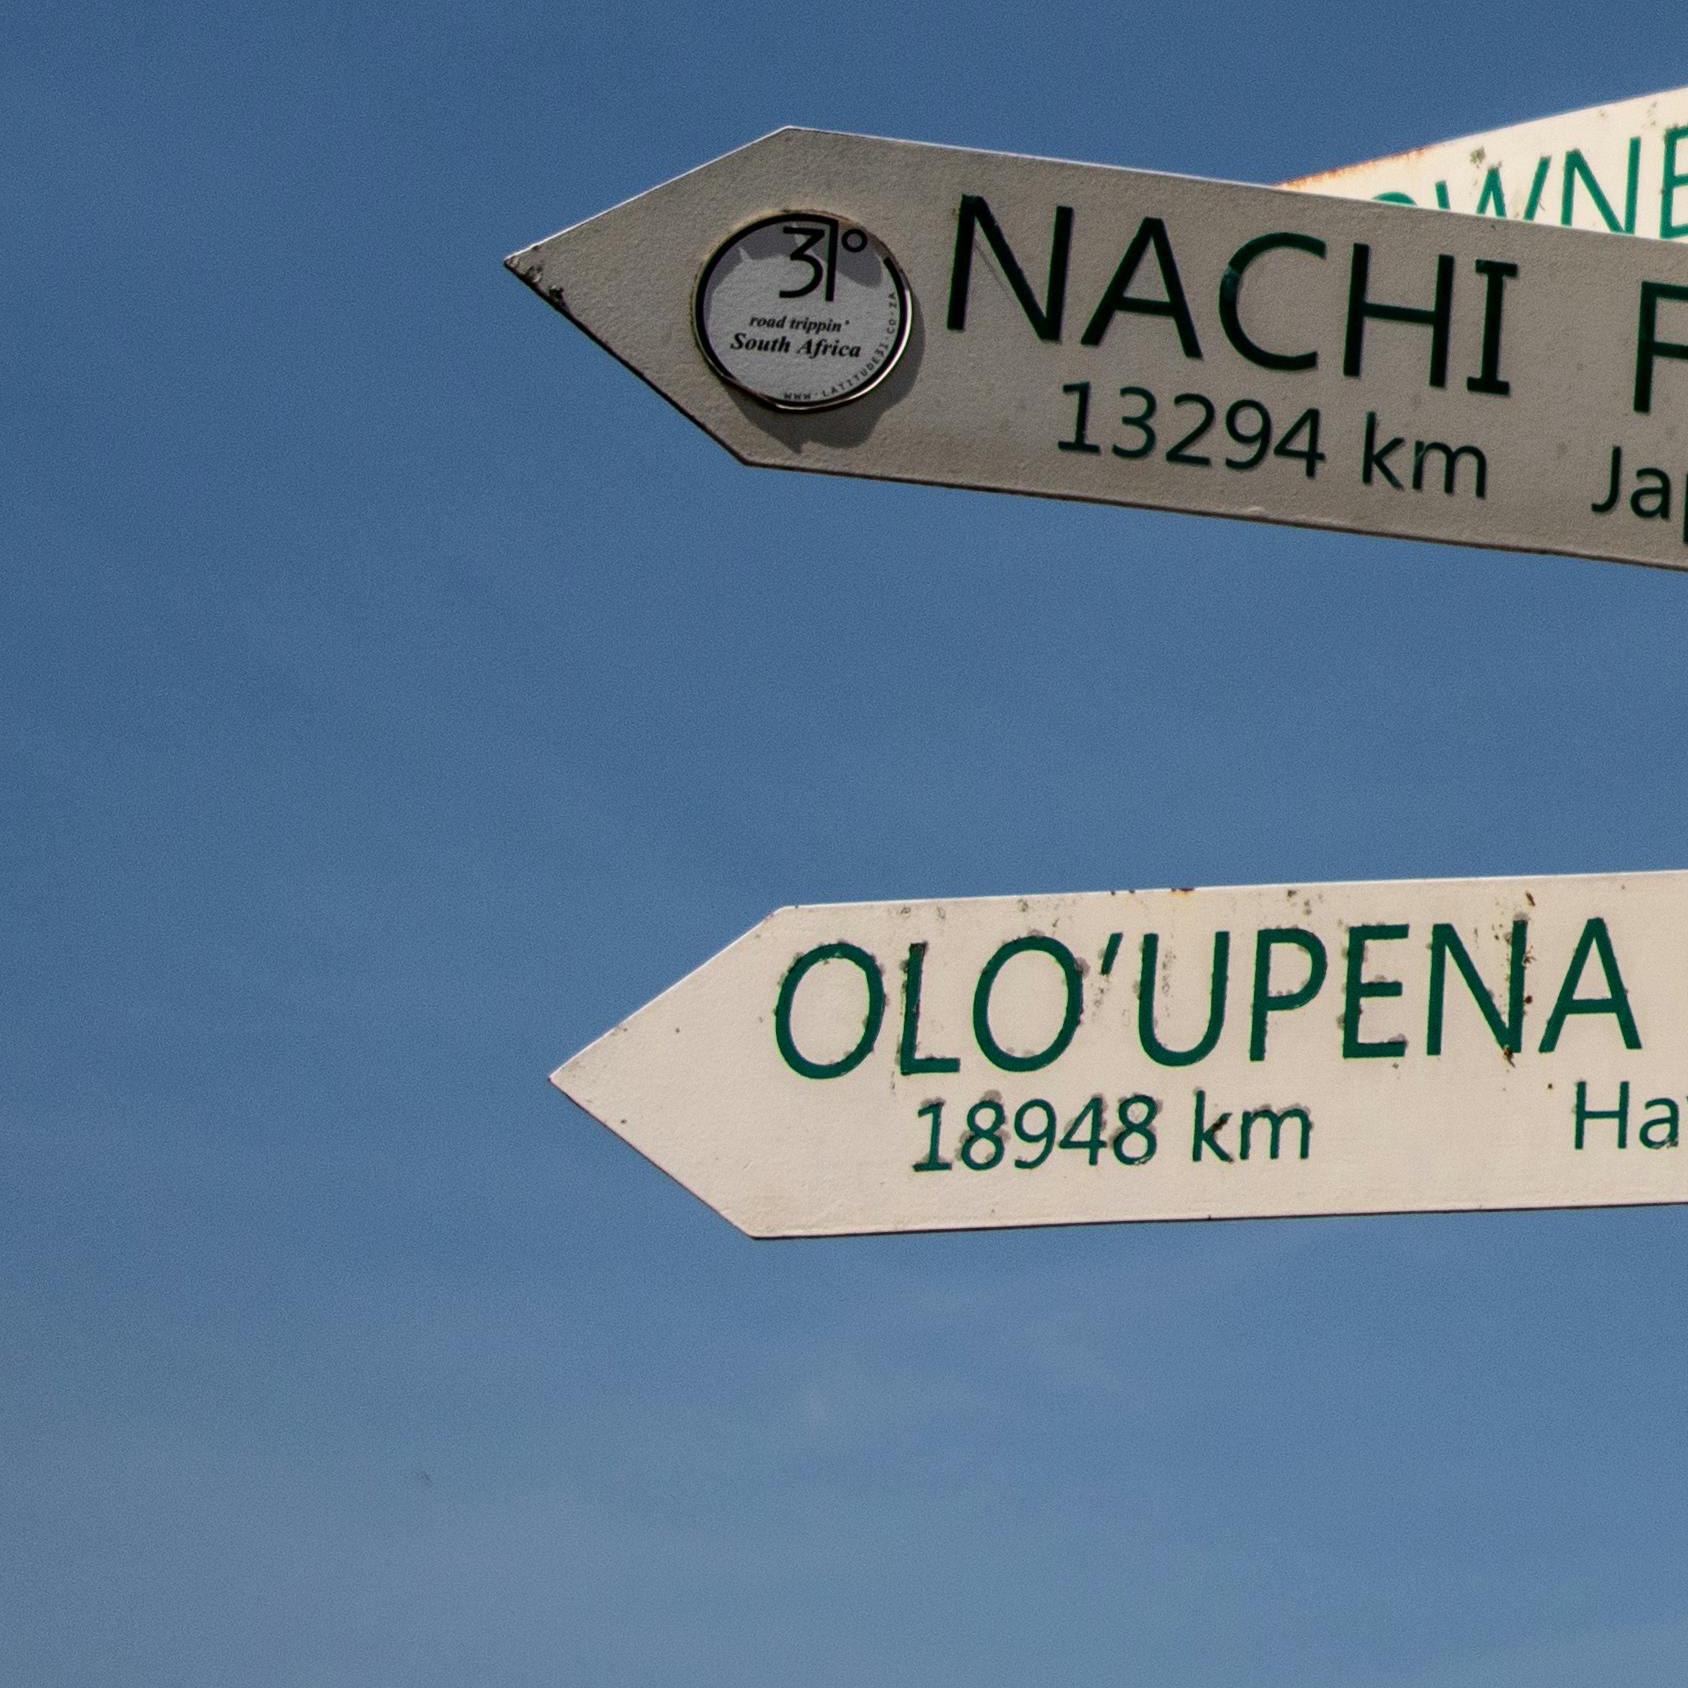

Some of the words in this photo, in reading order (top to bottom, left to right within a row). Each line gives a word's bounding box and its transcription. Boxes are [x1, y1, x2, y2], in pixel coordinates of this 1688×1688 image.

[730, 333, 790, 354] South
[796, 337, 862, 359] Africa
[749, 315, 787, 330] road
[945, 193, 1516, 400] NACHI
[1055, 381, 1328, 482] 13294
[1362, 409, 1489, 502] km
[772, 916, 1643, 1084] OLO'UPENA
[911, 1094, 1158, 1176] 18948
[1193, 1091, 1312, 1165] km
